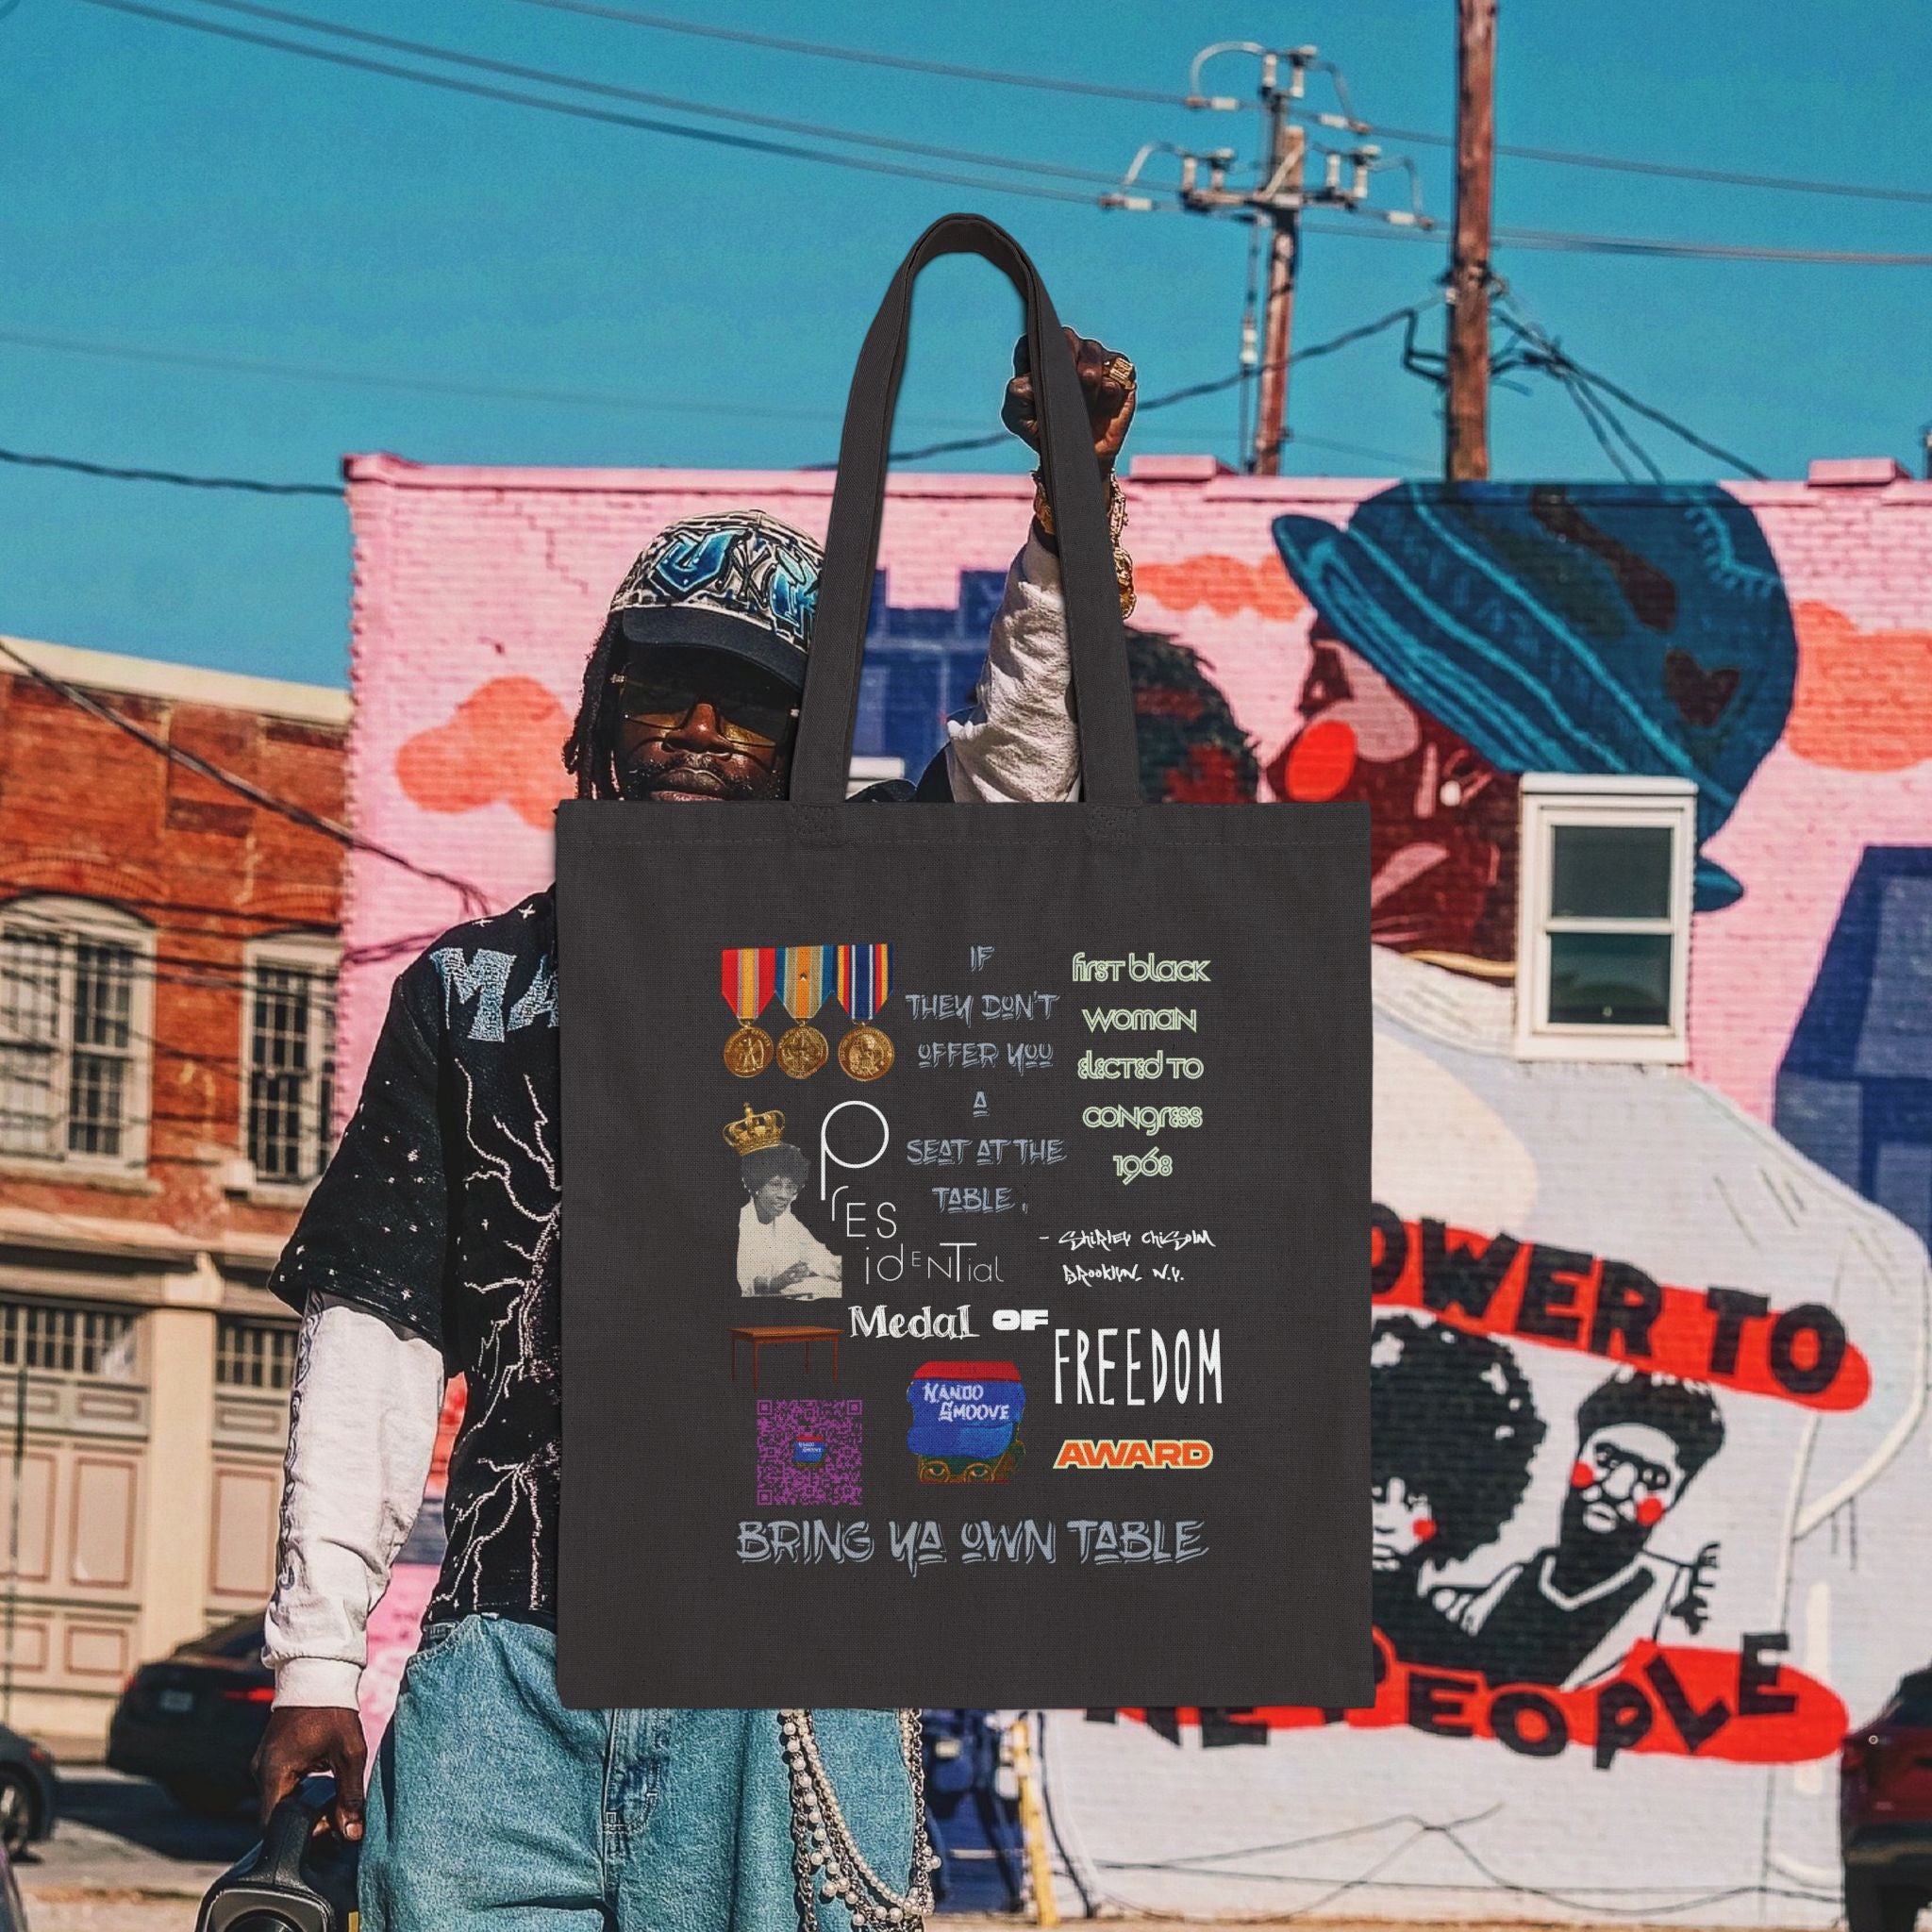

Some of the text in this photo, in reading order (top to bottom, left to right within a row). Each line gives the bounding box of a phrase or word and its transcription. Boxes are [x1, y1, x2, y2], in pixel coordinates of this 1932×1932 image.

[970, 945, 995, 972] IF
[1072, 952, 1212, 982] first black
[905, 991, 1060, 1028] THEY DON'T
[918, 1041, 999, 1068] OFFER
[1007, 1042, 1054, 1077] YOU
[973, 1091, 990, 1117] A
[907, 1139, 1068, 1166] SEAT AT THE
[1112, 1146, 1173, 1186] 1968
[992, 1308, 1049, 1331] OF
[1706, 1285, 1847, 1395] TO
[1055, 1328, 1223, 1406] FREEDOM
[1053, 1439, 1214, 1470] AWARD
[736, 1519, 1208, 1577] BRING YA OWN TABLE
